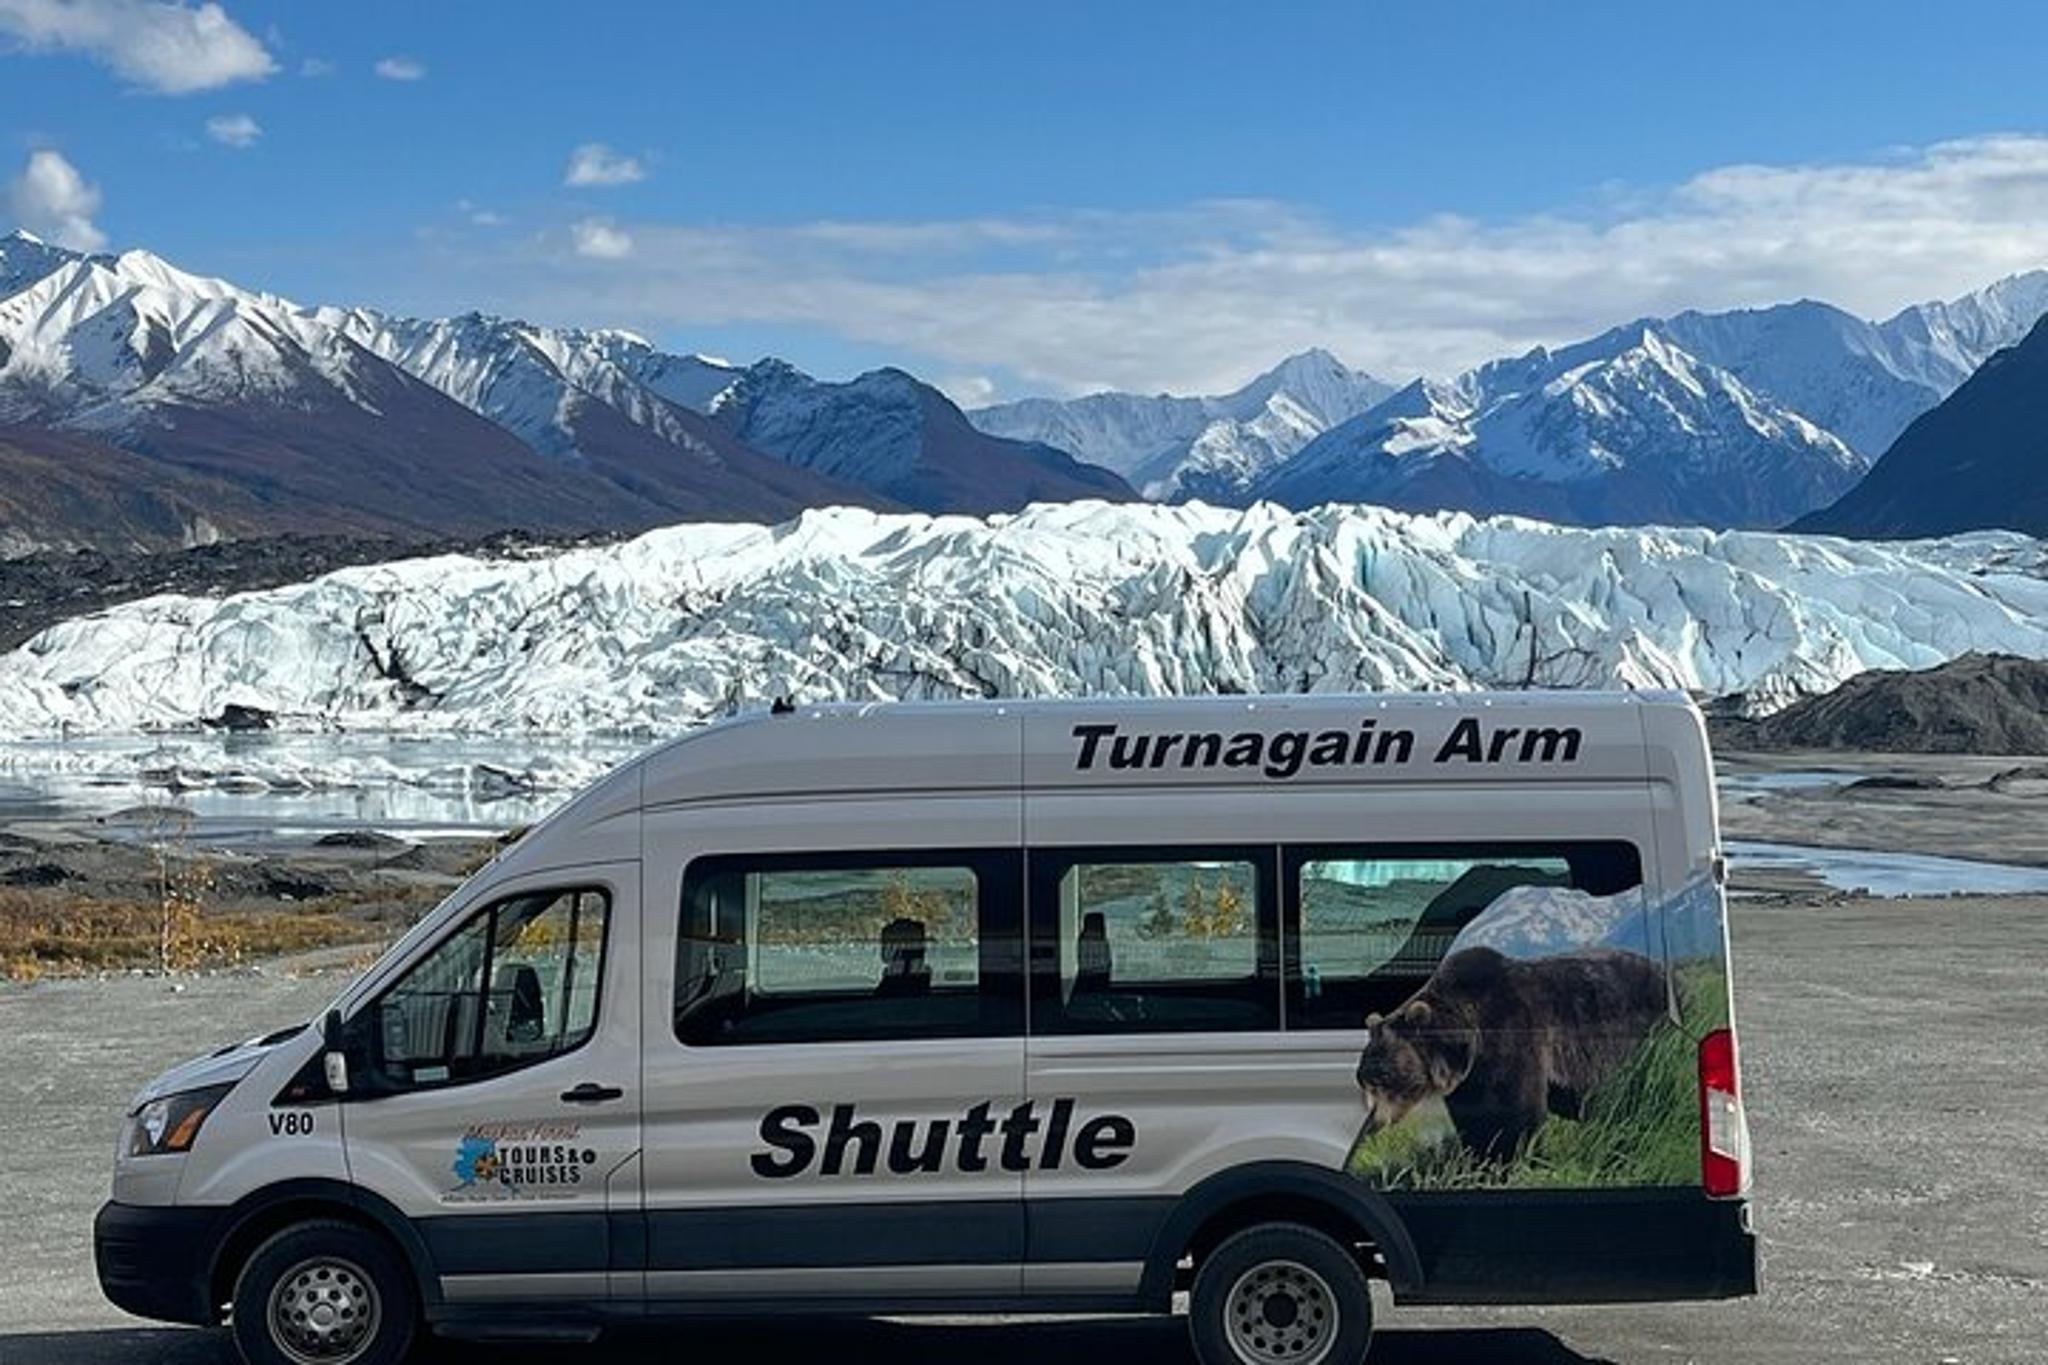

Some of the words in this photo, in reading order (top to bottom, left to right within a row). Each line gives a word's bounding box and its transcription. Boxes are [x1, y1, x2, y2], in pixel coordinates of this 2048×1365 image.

[1072, 719, 1415, 779] Turnagain
[1434, 717, 1583, 764] Arm
[268, 1112, 314, 1136] V80
[750, 1098, 1136, 1178] Shuttle
[500, 1165, 582, 1184] CRUISES
